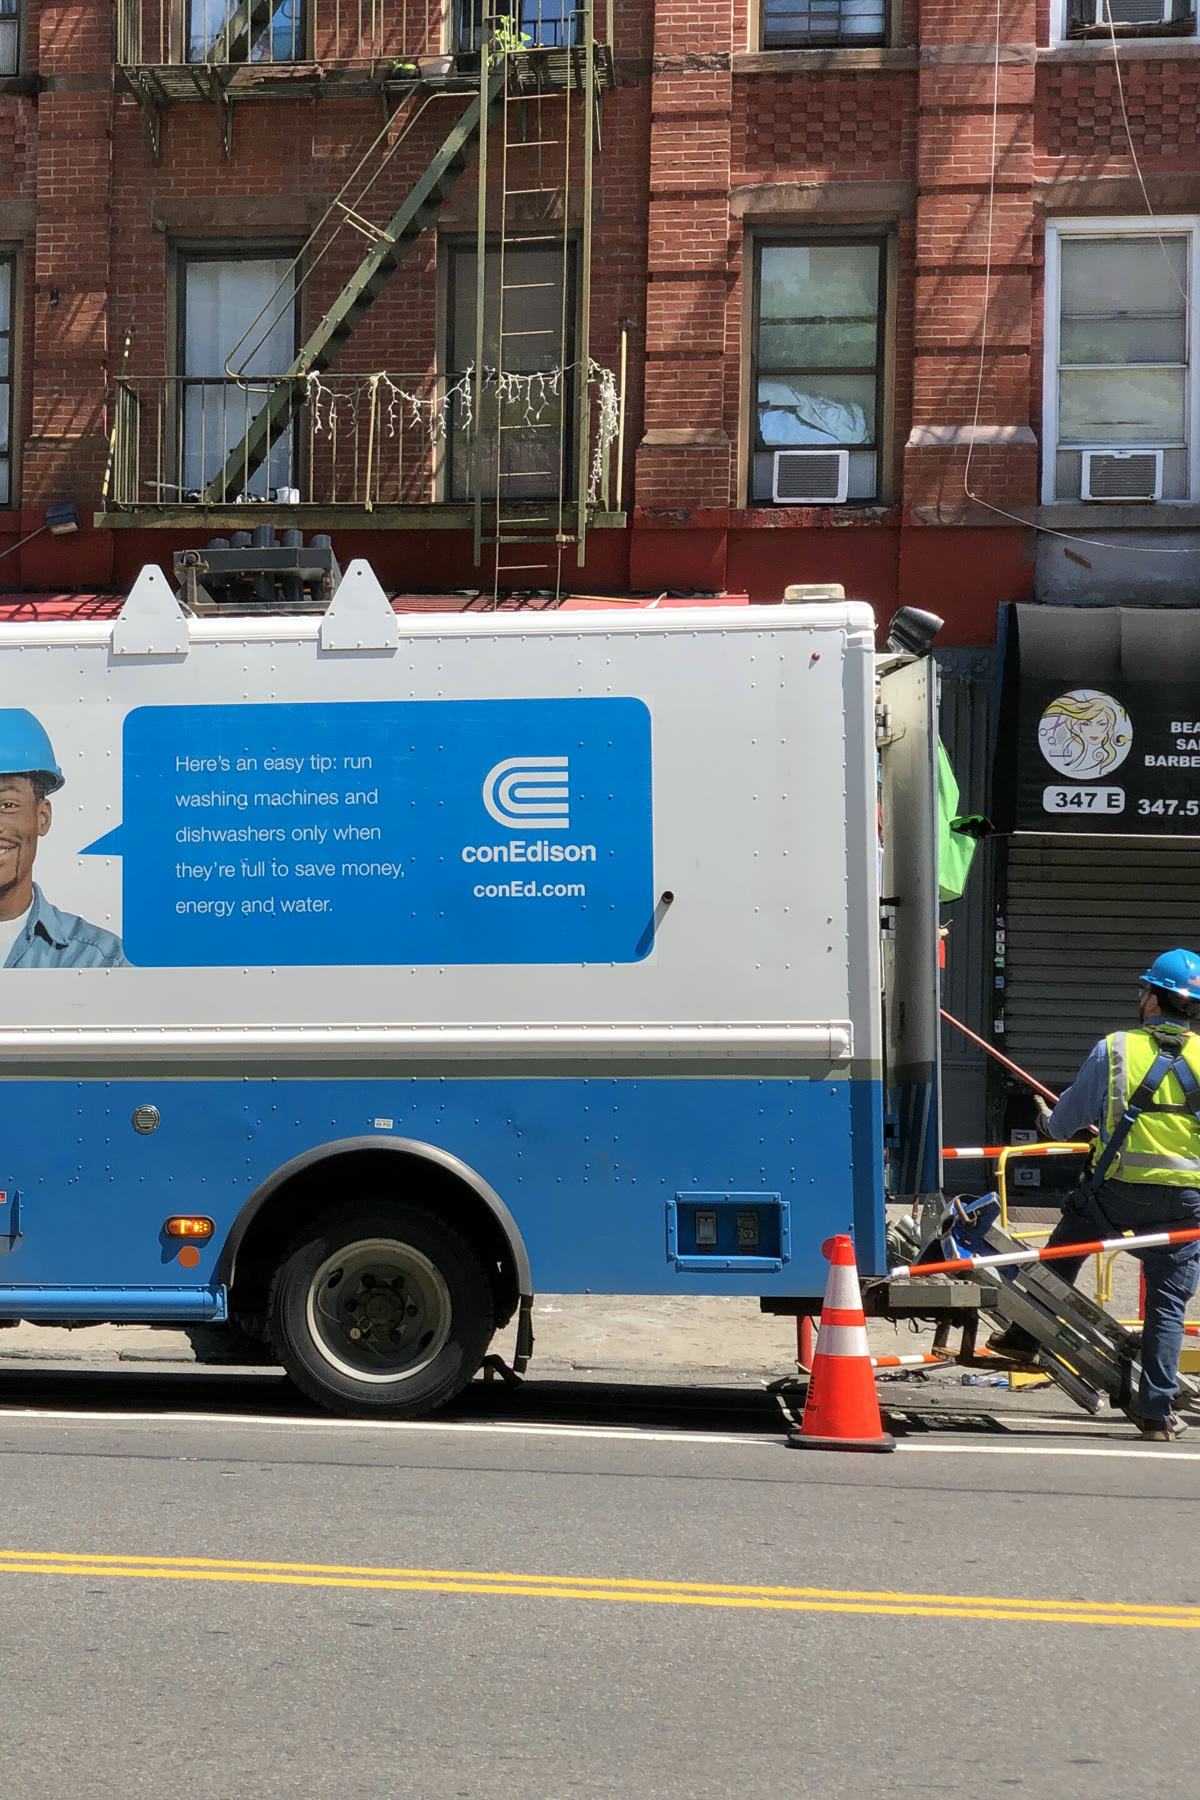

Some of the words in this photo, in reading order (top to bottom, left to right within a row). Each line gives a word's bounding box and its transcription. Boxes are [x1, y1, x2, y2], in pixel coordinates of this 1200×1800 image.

[175, 755, 231, 772] Here's
[236, 757, 257, 771] an
[263, 757, 305, 774] easy
[309, 753, 337, 773] tip:
[343, 756, 372, 770] run
[175, 790, 248, 810] washing
[254, 789, 339, 806] machines
[344, 788, 378, 805] and
[1055, 791, 1098, 809] 347
[1106, 792, 1121, 809] E
[175, 826, 286, 843] dishwashers
[291, 824, 328, 844] only
[333, 824, 381, 841] when
[462, 840, 597, 863] conEdison
[175, 861, 236, 882] they're
[241, 860, 265, 878] full
[272, 861, 289, 877] to
[294, 864, 336, 877] save
[341, 863, 405, 880] money,
[473, 880, 586, 898] conEd.com
[175, 900, 236, 917] energy
[241, 896, 274, 913] and
[280, 897, 333, 913] water.
